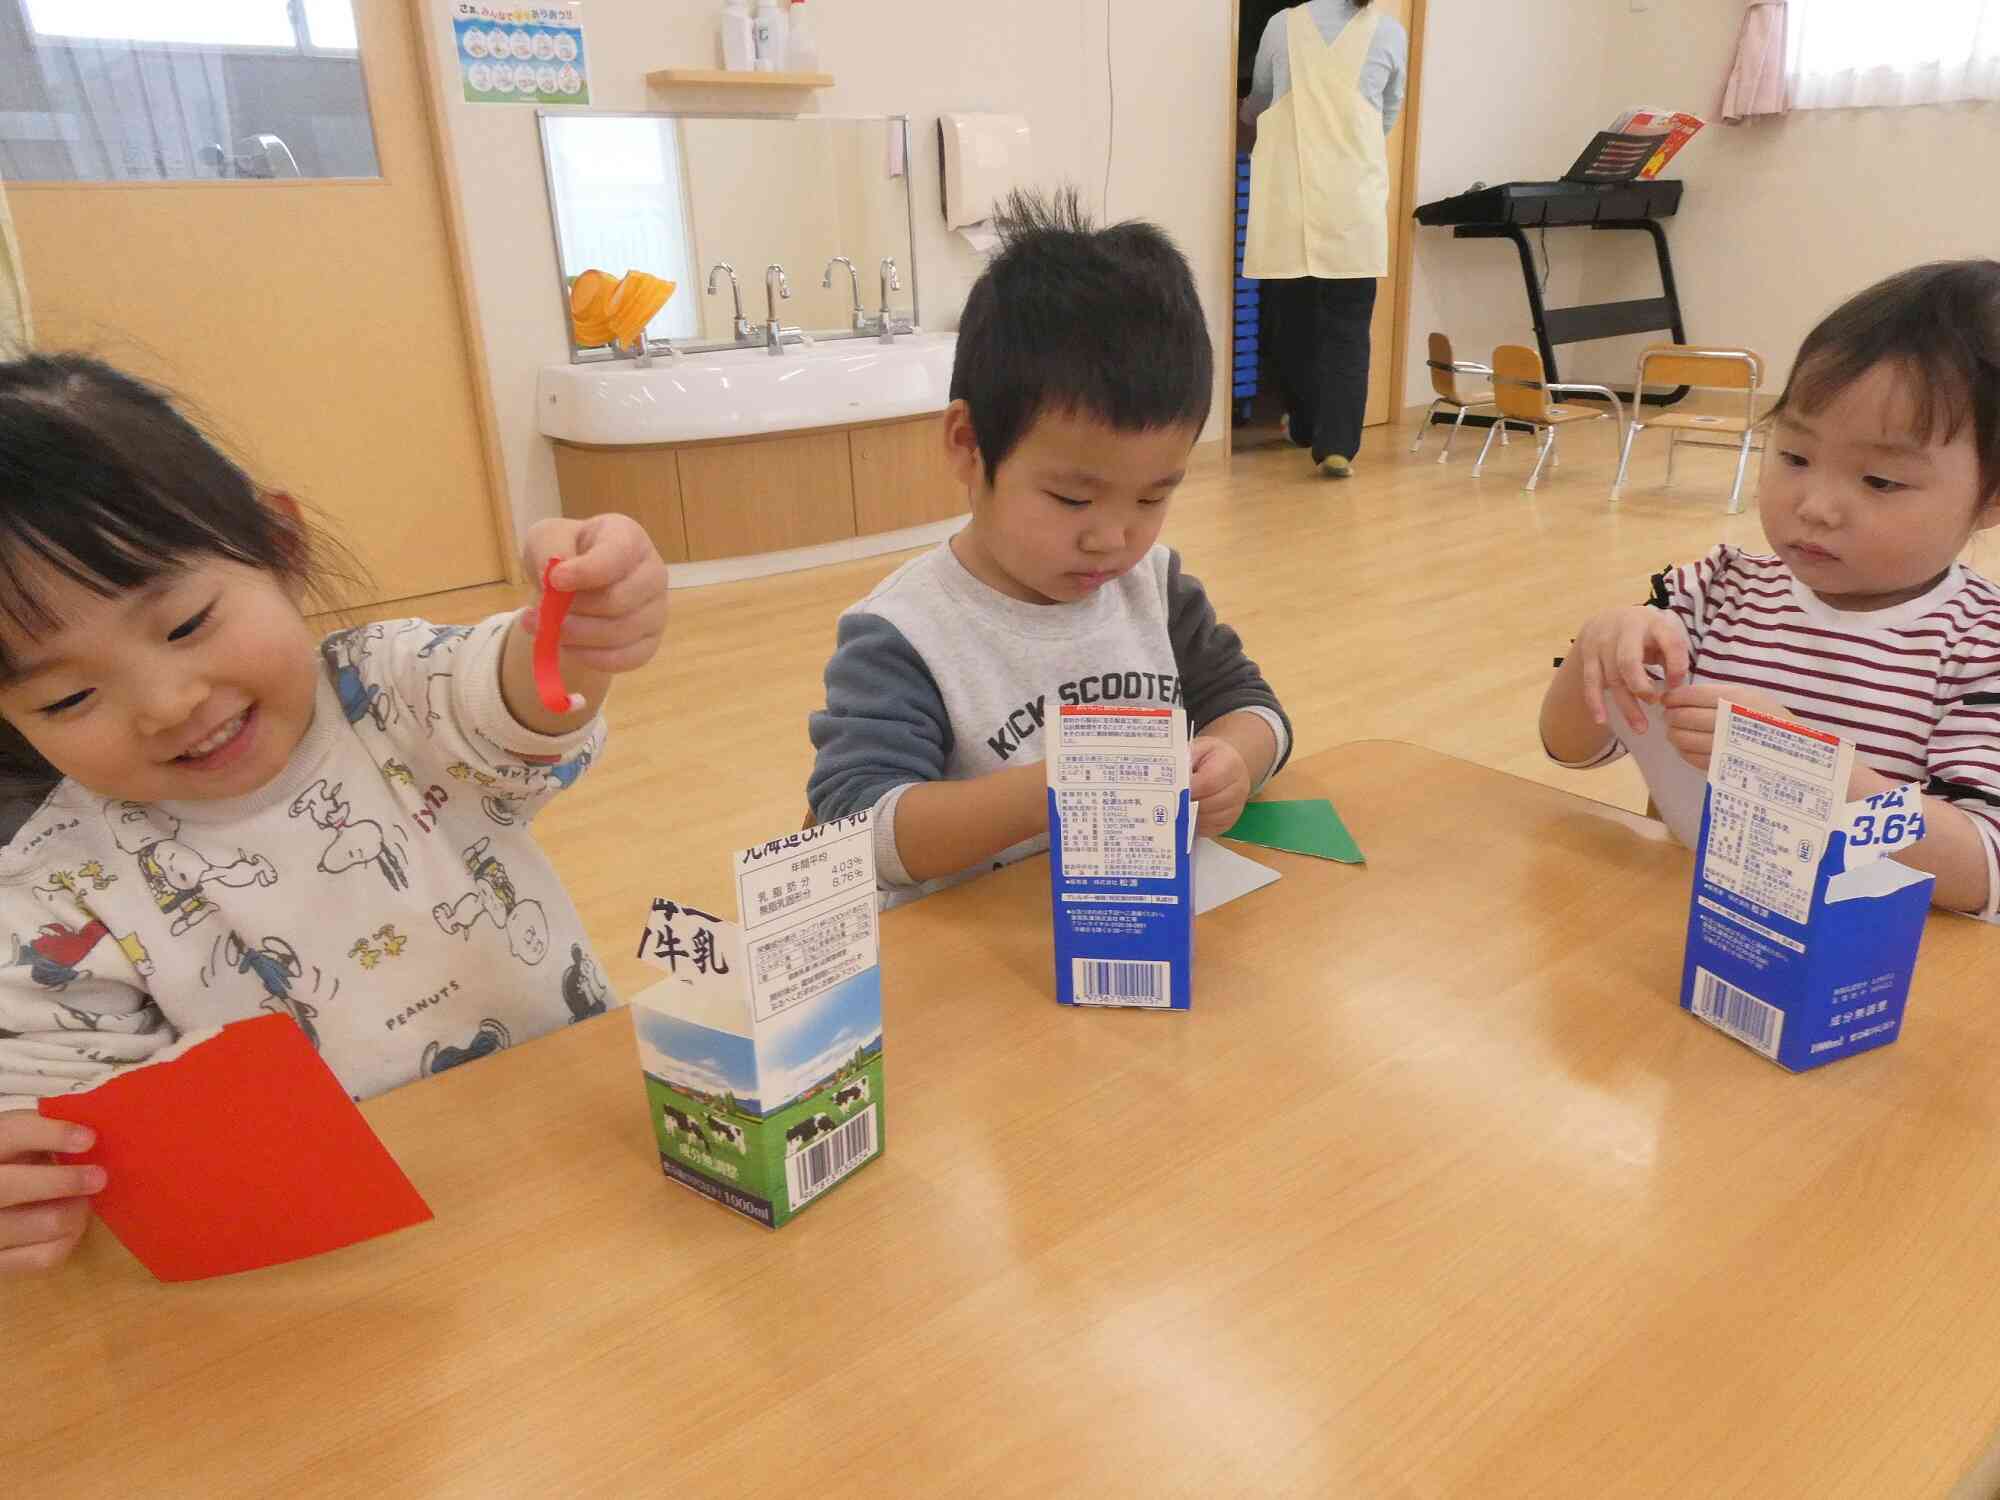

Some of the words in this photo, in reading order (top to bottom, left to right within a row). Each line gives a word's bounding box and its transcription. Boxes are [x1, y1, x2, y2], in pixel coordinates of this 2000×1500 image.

[987, 695, 1045, 760] KICK
[385, 980, 459, 1031] PEANUTS
[724, 1191, 769, 1220] 1000ml
